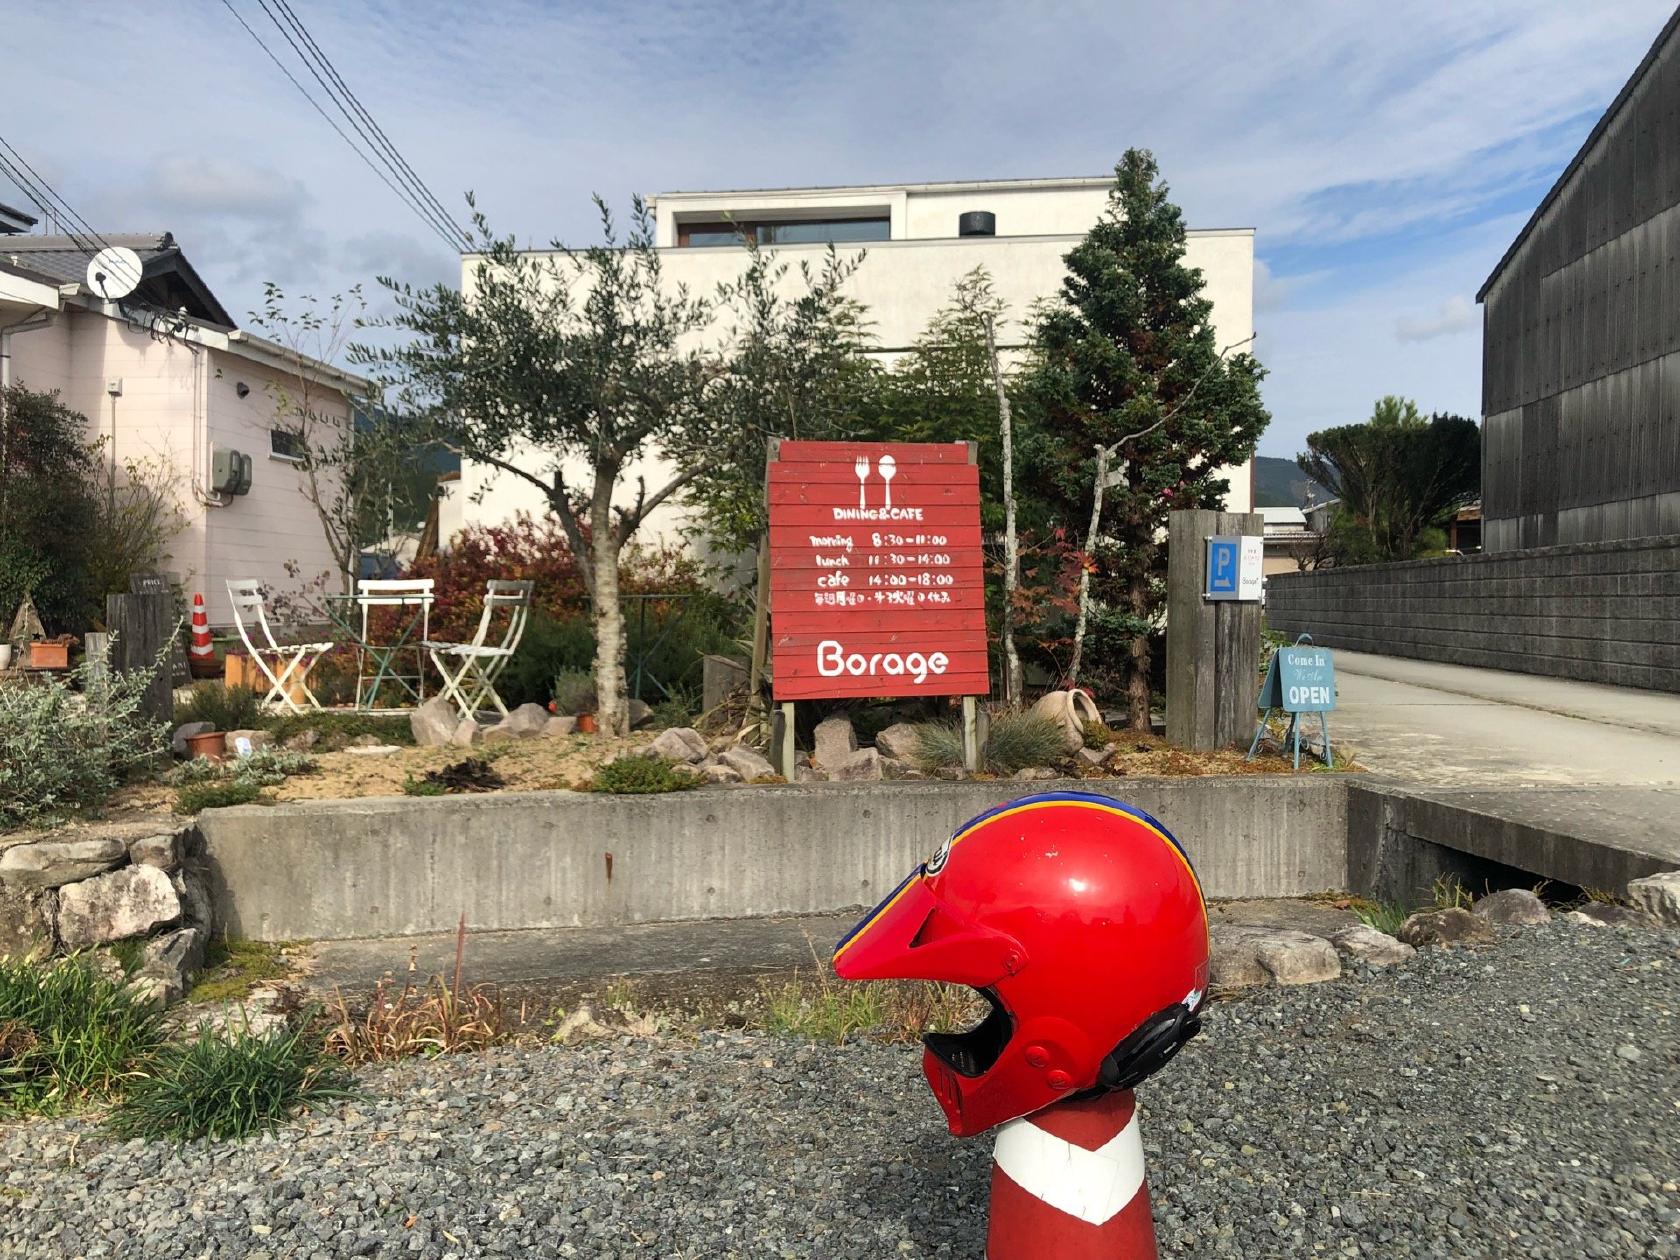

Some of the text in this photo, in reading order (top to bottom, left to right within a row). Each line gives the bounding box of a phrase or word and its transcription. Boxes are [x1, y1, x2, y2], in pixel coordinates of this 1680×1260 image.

[808, 534, 854, 553] morning
[815, 554, 850, 567] lunch
[1217, 547, 1230, 576] P
[817, 570, 850, 588] cafe
[816, 640, 949, 684] Borage
[1287, 654, 1325, 667] Come In
[1289, 686, 1330, 704] OPEN
